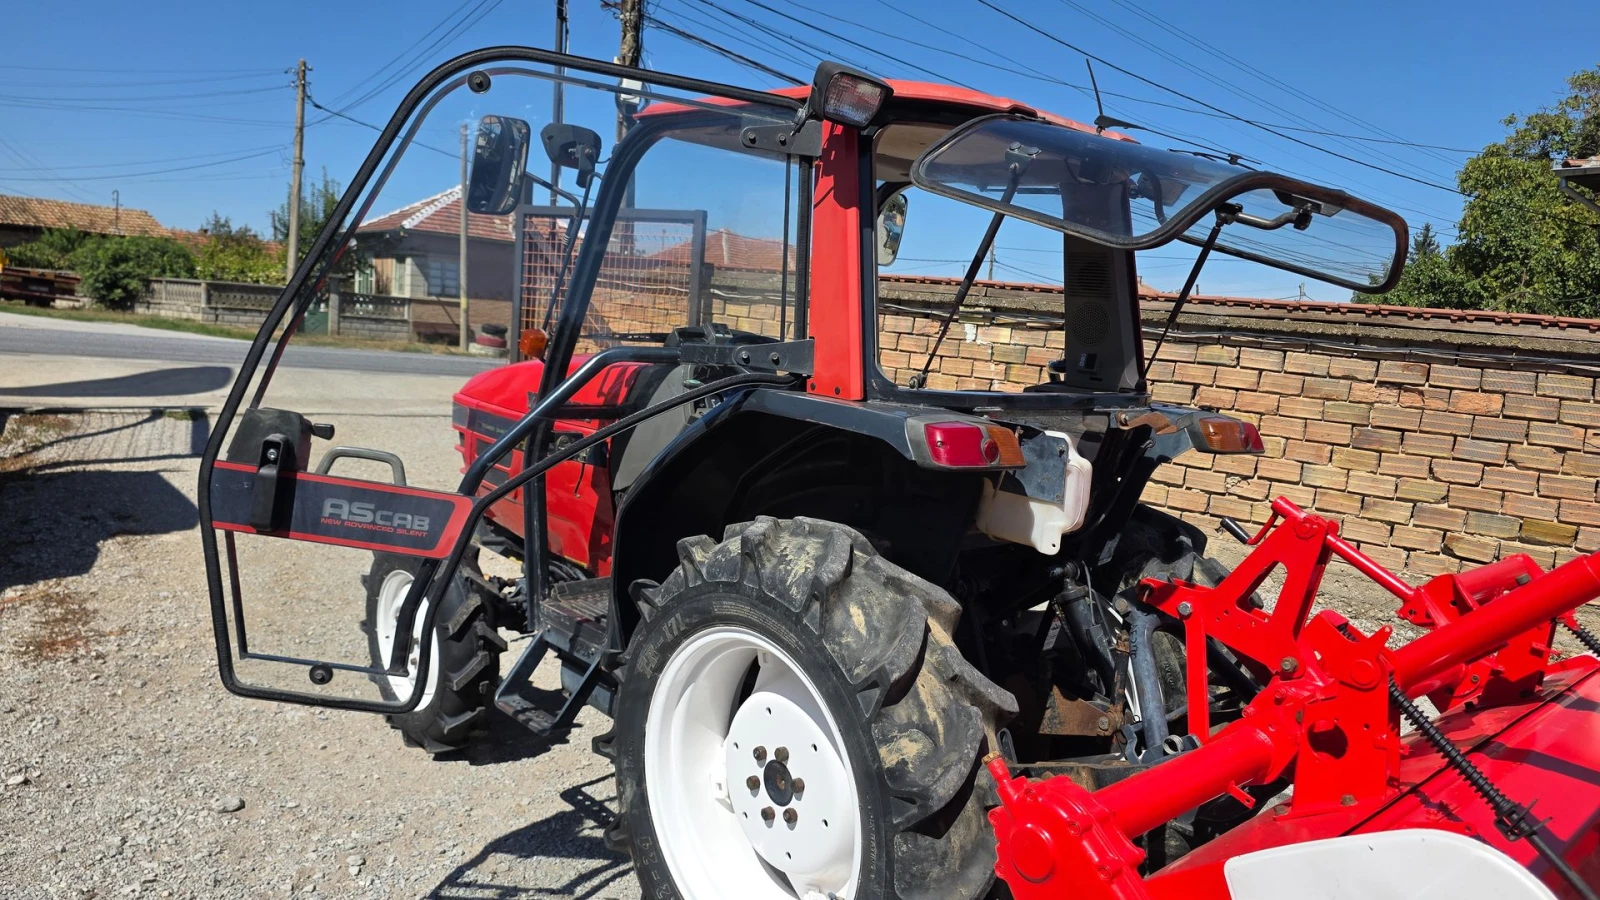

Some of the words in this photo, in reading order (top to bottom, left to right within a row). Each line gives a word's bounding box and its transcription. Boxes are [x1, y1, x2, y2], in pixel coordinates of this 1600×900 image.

[320, 518, 341, 526] NEW
[344, 521, 393, 533] ADVANCED
[396, 528, 428, 537] SILENT
